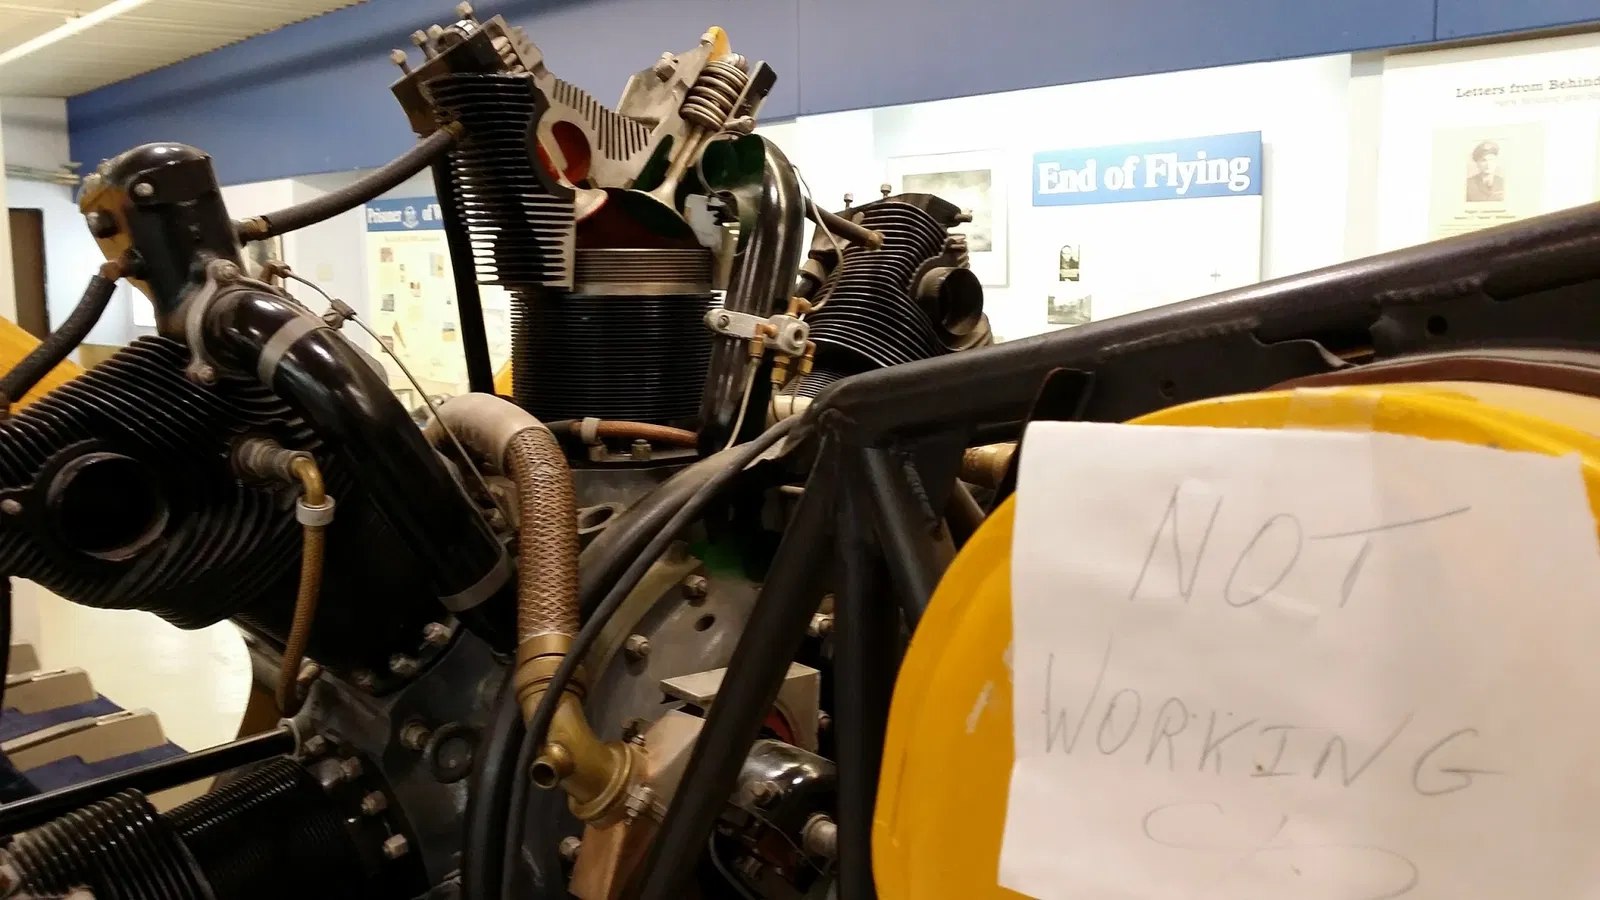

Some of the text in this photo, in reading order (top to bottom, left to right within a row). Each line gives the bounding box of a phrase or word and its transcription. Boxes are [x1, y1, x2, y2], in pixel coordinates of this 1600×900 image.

[1510, 83, 1543, 94] from
[1038, 150, 1252, 195] End of Flying
[1131, 485, 1471, 608] NOT
[1041, 632, 1505, 797] WORKING
